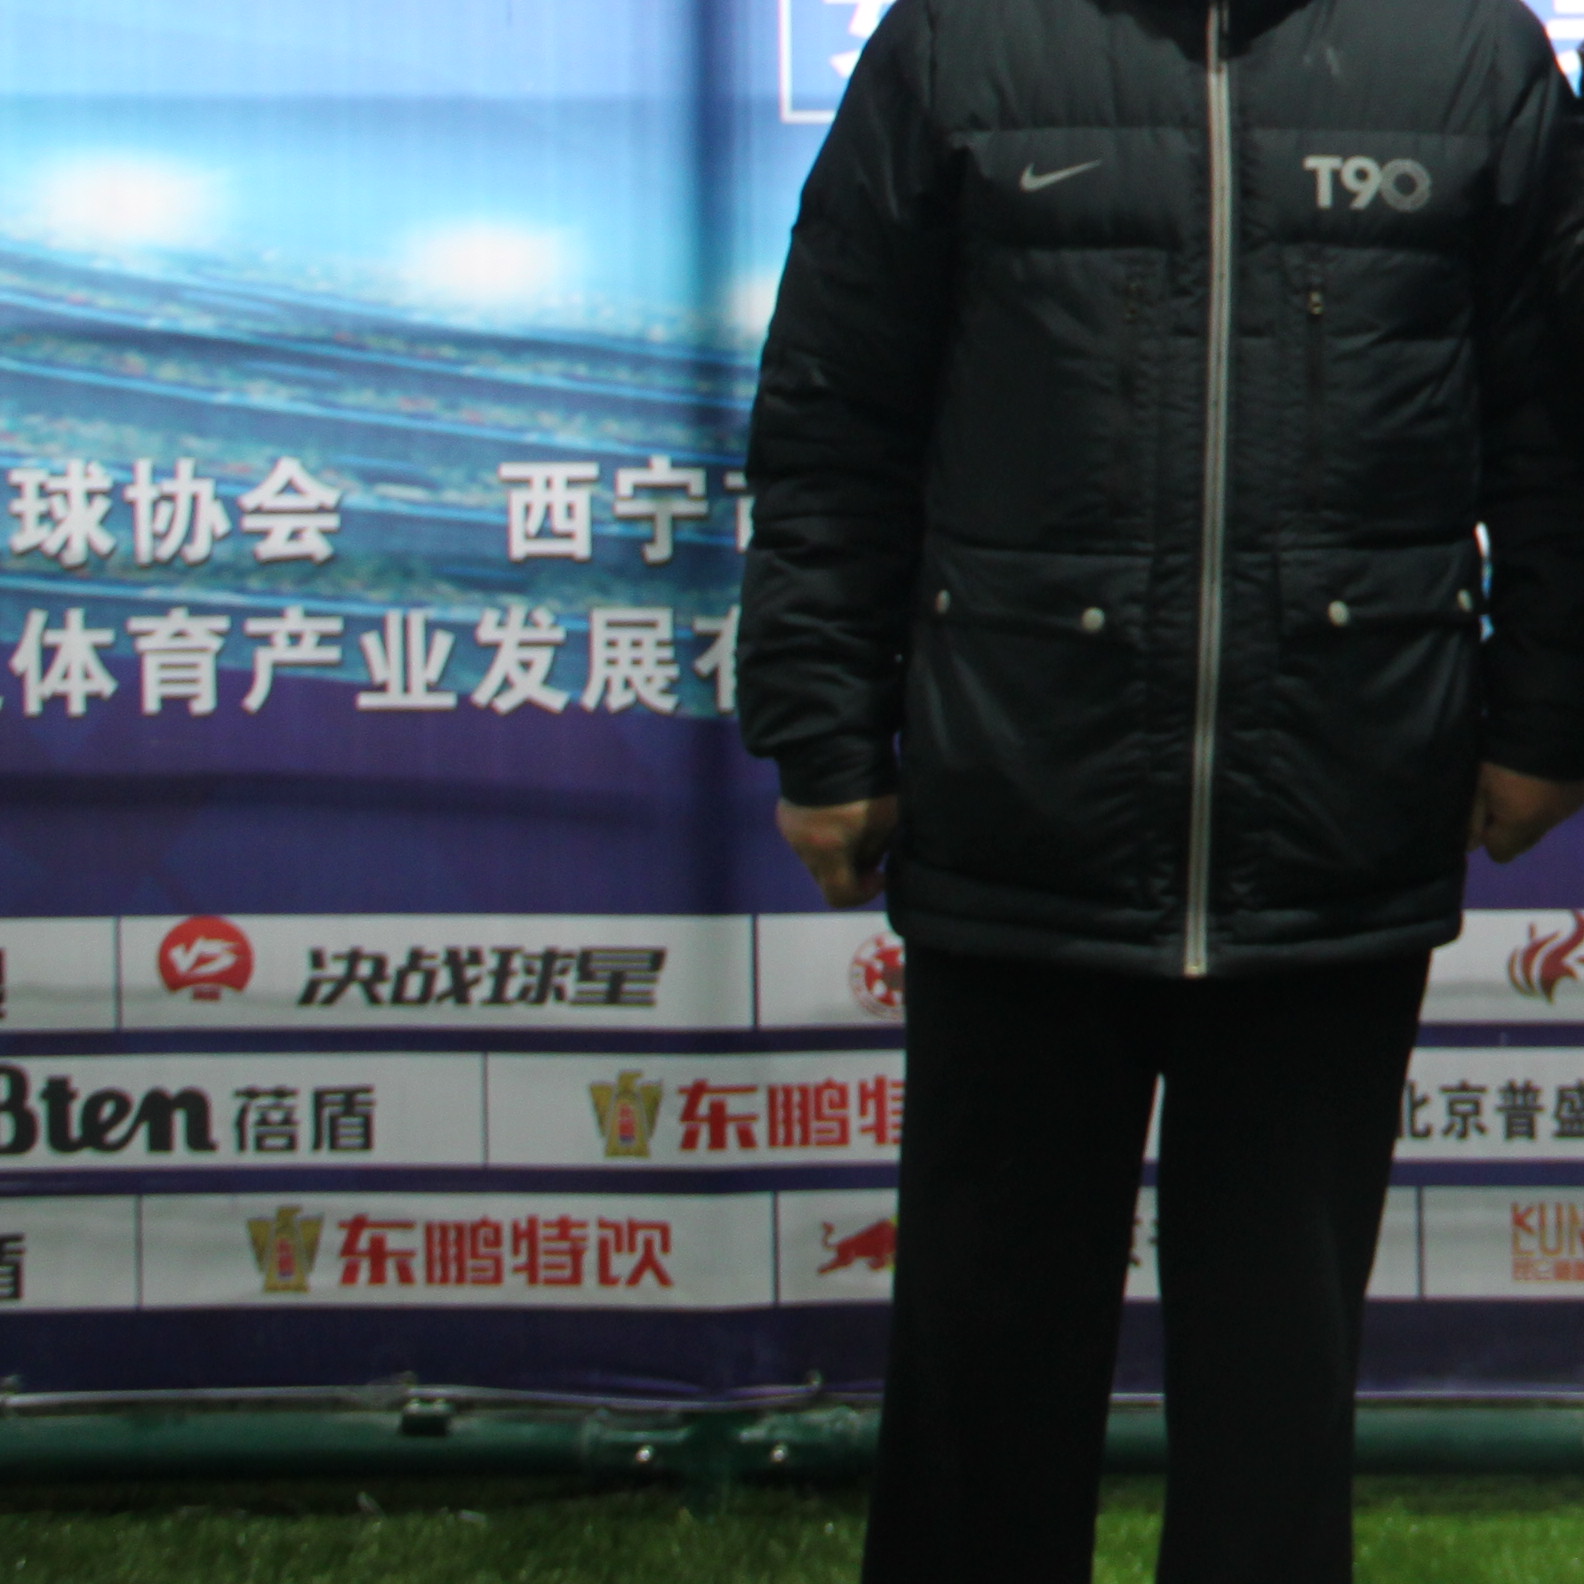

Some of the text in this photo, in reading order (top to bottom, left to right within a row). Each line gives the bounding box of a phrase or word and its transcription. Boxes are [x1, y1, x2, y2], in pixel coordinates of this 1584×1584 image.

[1304, 155, 1433, 211] T90
[8, 456, 343, 566] 球协会
[298, 946, 669, 1007] 决战球星
[337, 1213, 674, 1289] 东鹏特饮
